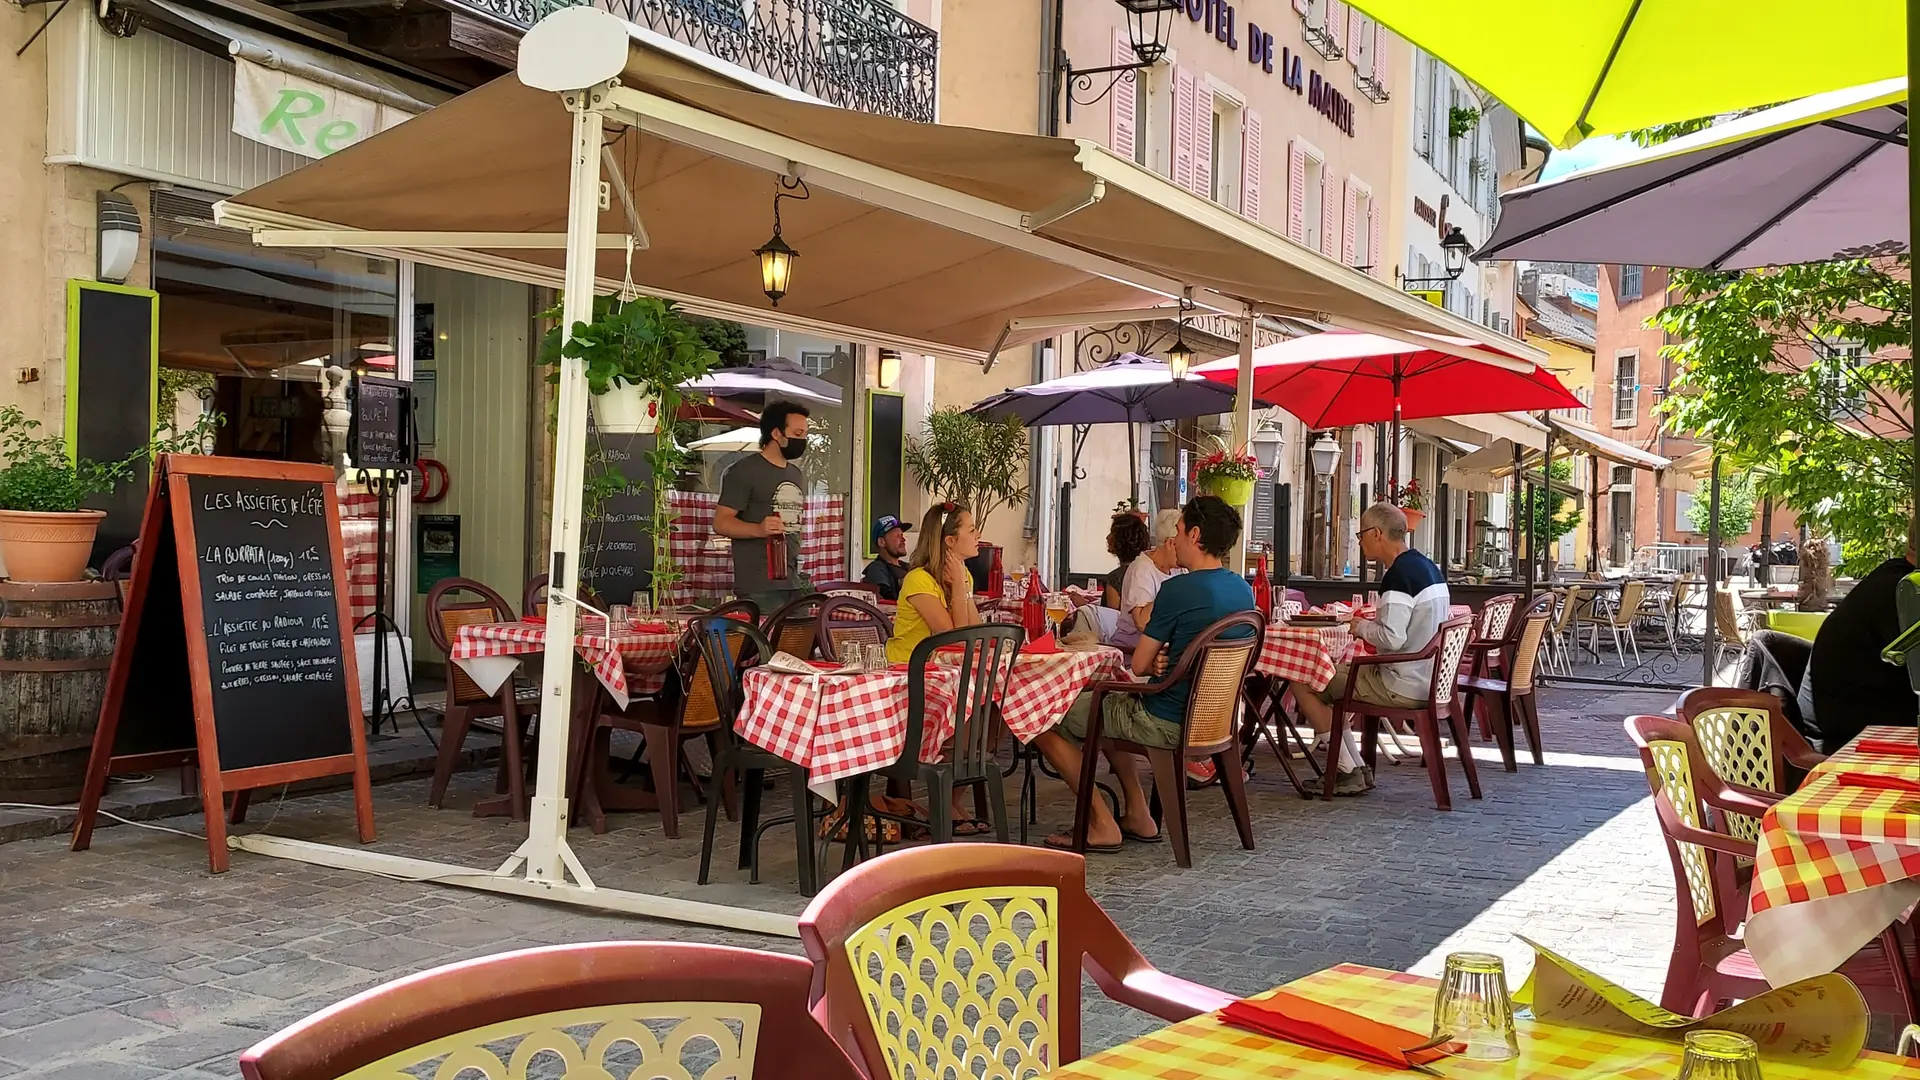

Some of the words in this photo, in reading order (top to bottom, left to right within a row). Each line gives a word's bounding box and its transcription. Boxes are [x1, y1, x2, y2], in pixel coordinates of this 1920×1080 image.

[1177, 0, 1238, 50] OTEL
[1248, 22, 1273, 74] DE
[1282, 47, 1303, 95] LA
[1308, 69, 1355, 138] MAIRIE
[204, 493, 232, 510] LES
[236, 490, 287, 514] ASSIETTES
[291, 498, 298, 516] DE
[225, 545, 265, 565] BURRATA
[216, 570, 234, 584] TRIO
[237, 574, 246, 583] DE
[248, 573, 271, 581] COULIS
[215, 591, 242, 602] SALADE
[262, 620, 271, 632] DU
[274, 611, 304, 628] RABIOUX
[219, 641, 237, 654] FILET
[240, 640, 247, 652] DE
[249, 639, 269, 650] TRUITE
[251, 659, 269, 670] TERRE
